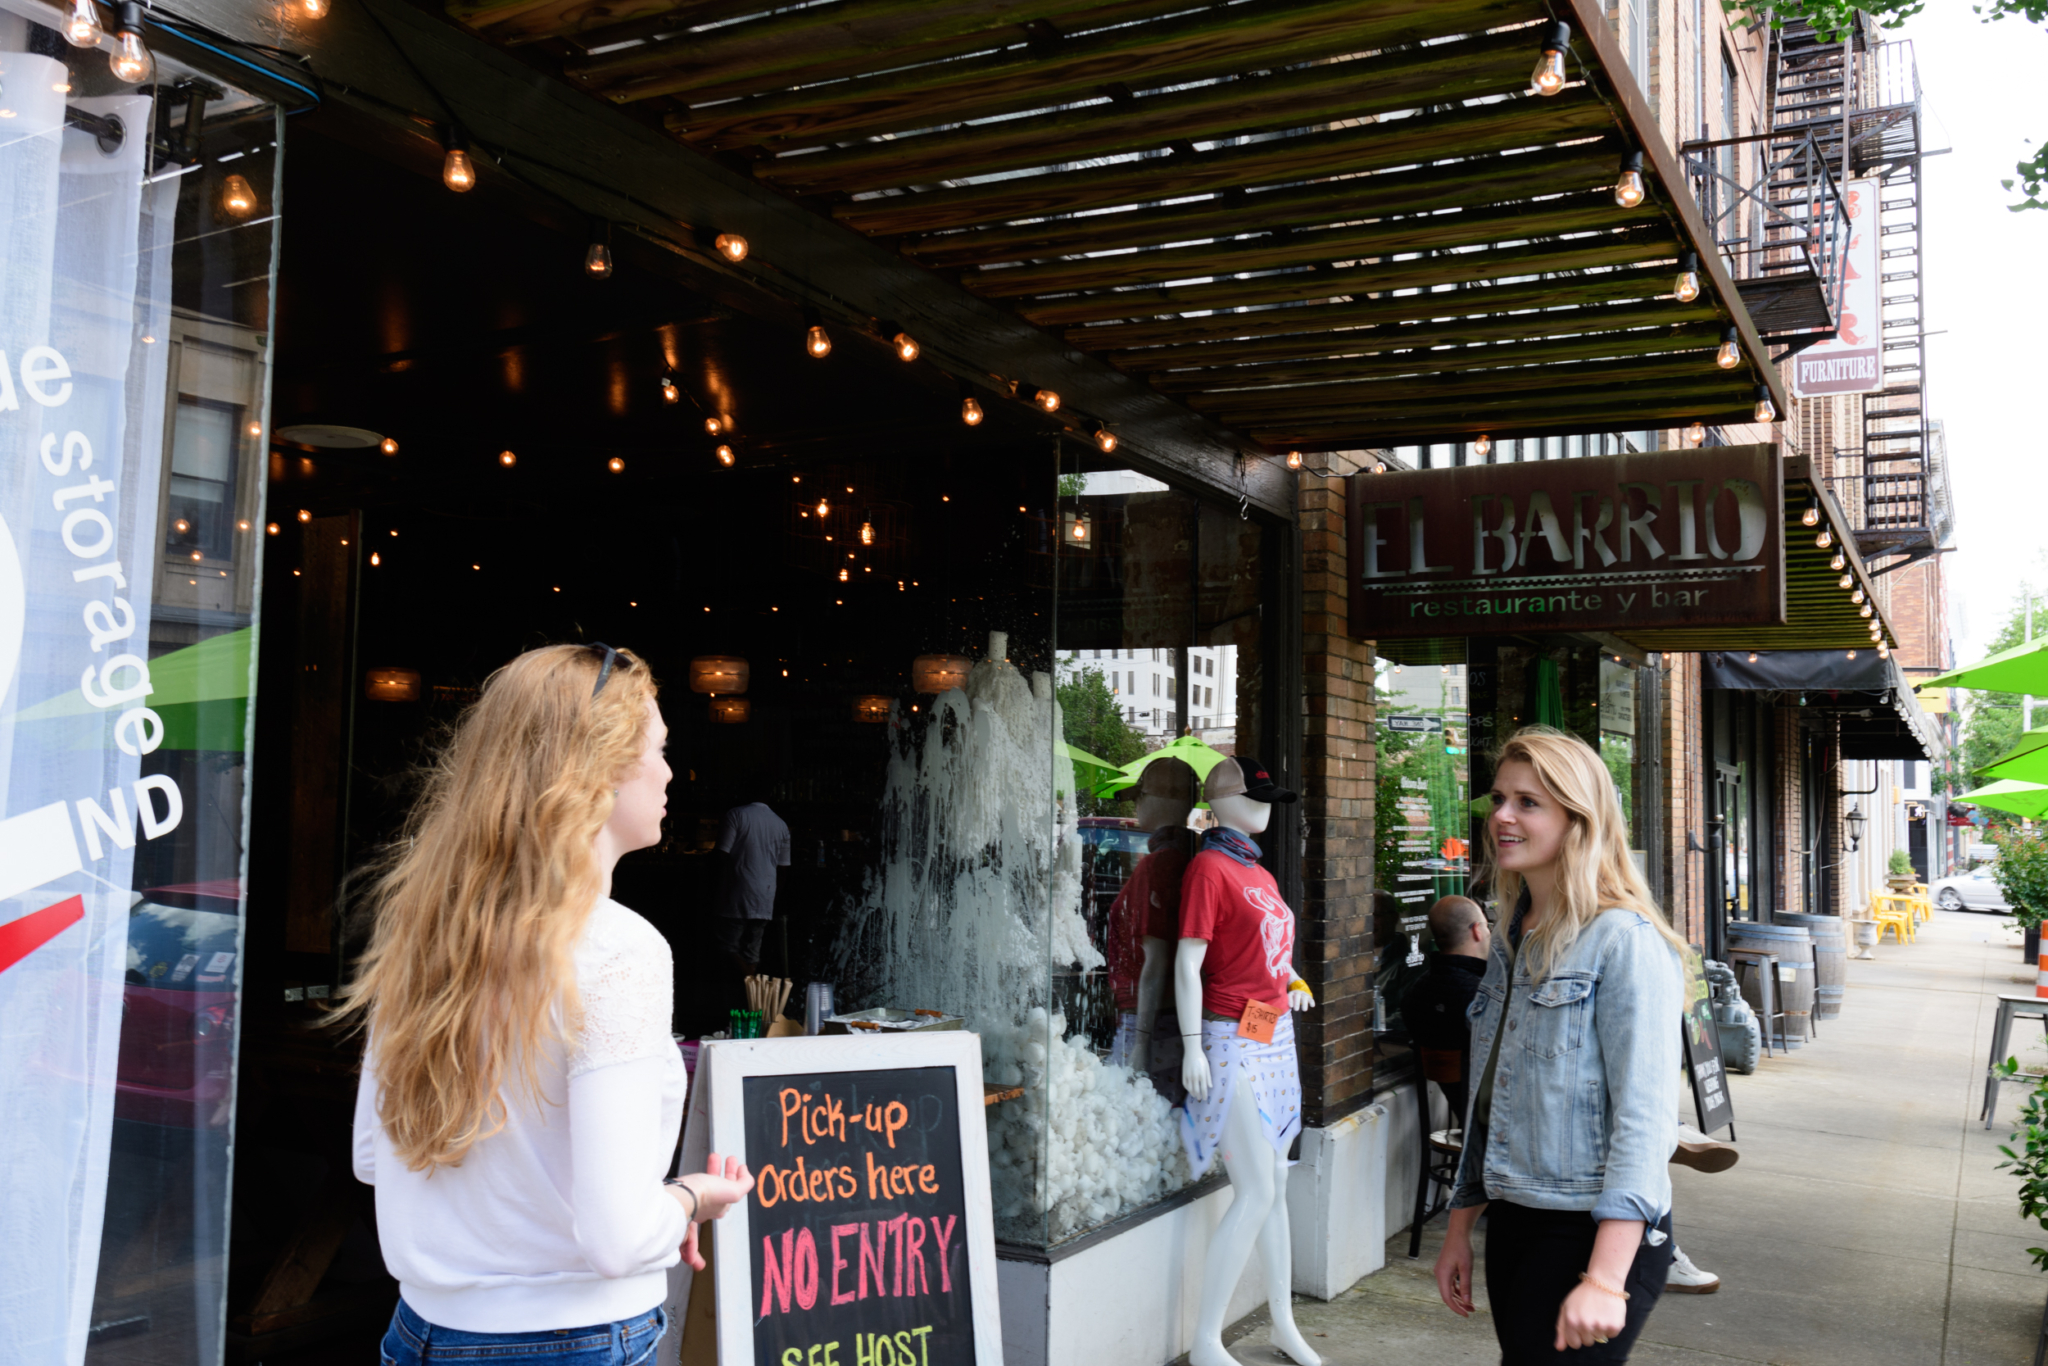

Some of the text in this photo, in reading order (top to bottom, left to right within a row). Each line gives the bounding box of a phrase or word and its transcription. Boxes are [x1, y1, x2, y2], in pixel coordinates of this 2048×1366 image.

[1801, 355, 1876, 383] FURNITURE
[1361, 478, 1768, 579] EL BARRIO
[40, 430, 165, 757] storage
[1410, 584, 1710, 618] restaurante y bar
[1245, 1021, 1258, 1034] $15
[779, 1087, 908, 1149] Pick-up
[866, 1152, 940, 1201] here
[760, 1212, 958, 1317] NO ENTRY
[855, 1325, 933, 1366] HOST
